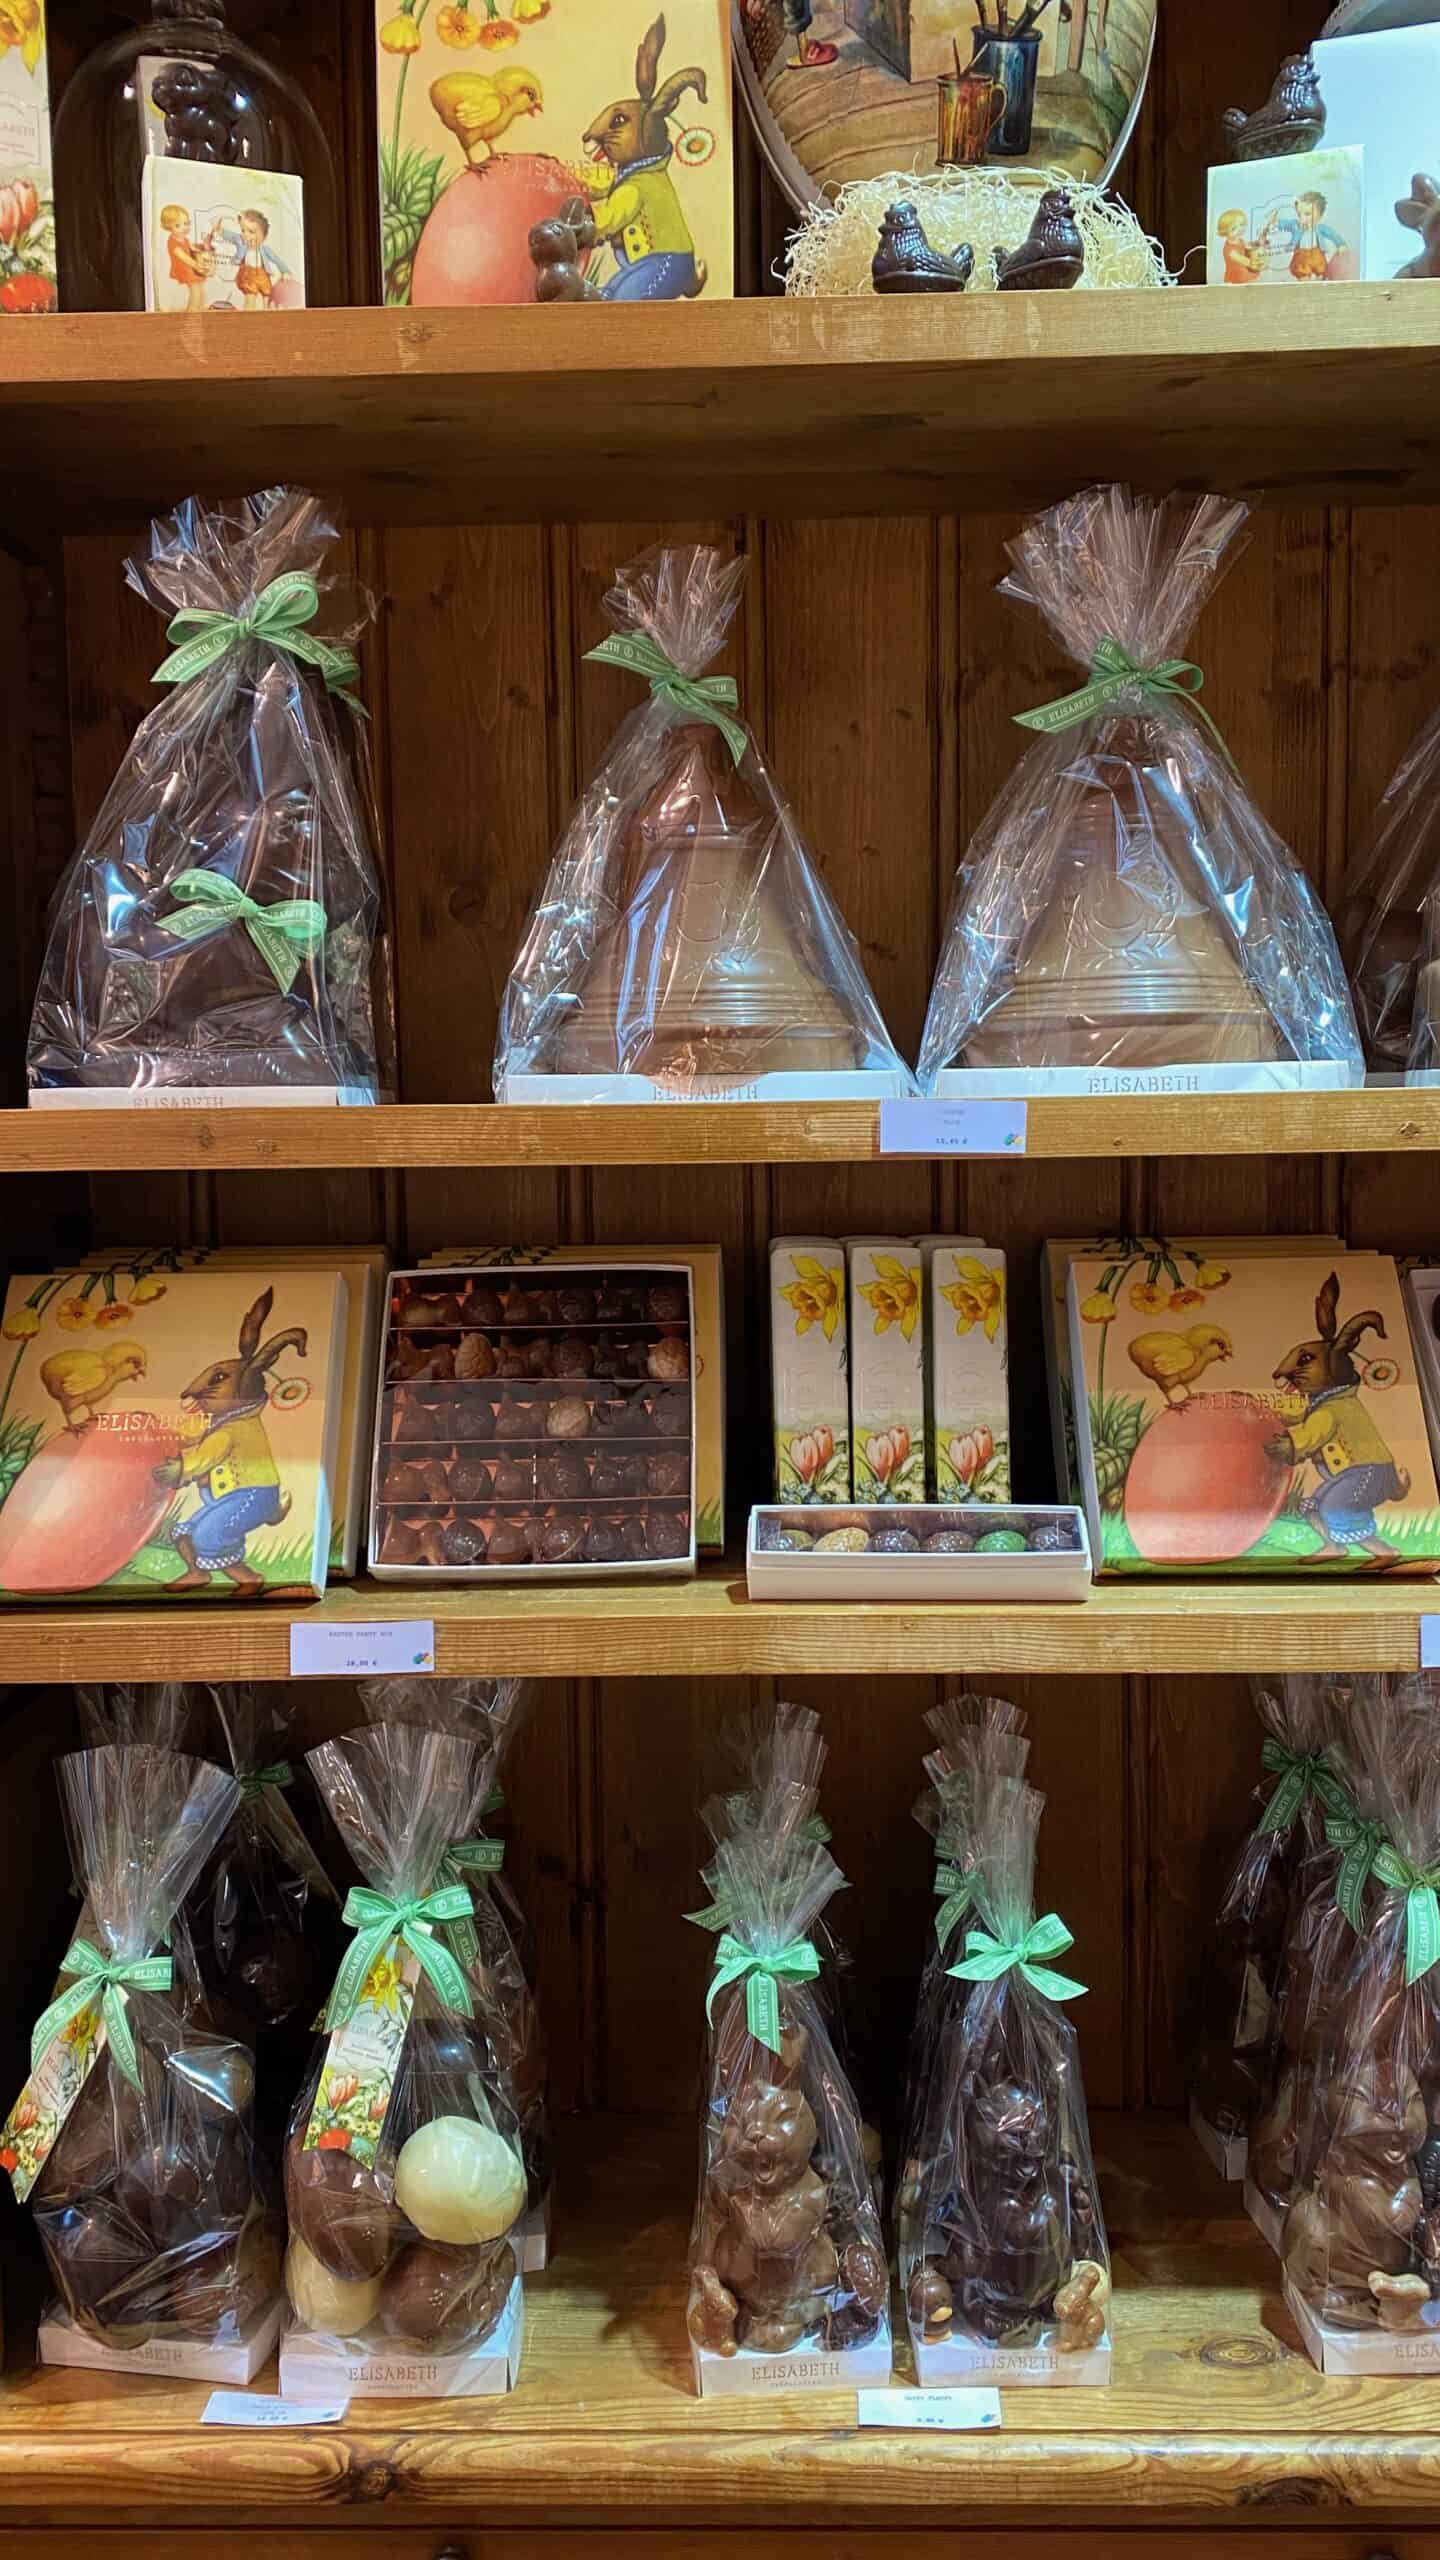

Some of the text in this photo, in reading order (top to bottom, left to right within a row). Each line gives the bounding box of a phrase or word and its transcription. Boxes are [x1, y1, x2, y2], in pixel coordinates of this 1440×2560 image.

[1048, 693, 1095, 722] ELISABETH
[1087, 1075, 1199, 1094] ELISABETH
[96, 1412, 214, 1432] ELISABETH
[344, 1940, 372, 1990] ELISABETH
[1394, 2343, 1440, 2359] ELISA
[751, 2361, 840, 2381] ELISABETH
[970, 2354, 1058, 2369] ELISABETH
[349, 2365, 438, 2382] ELISABETH
